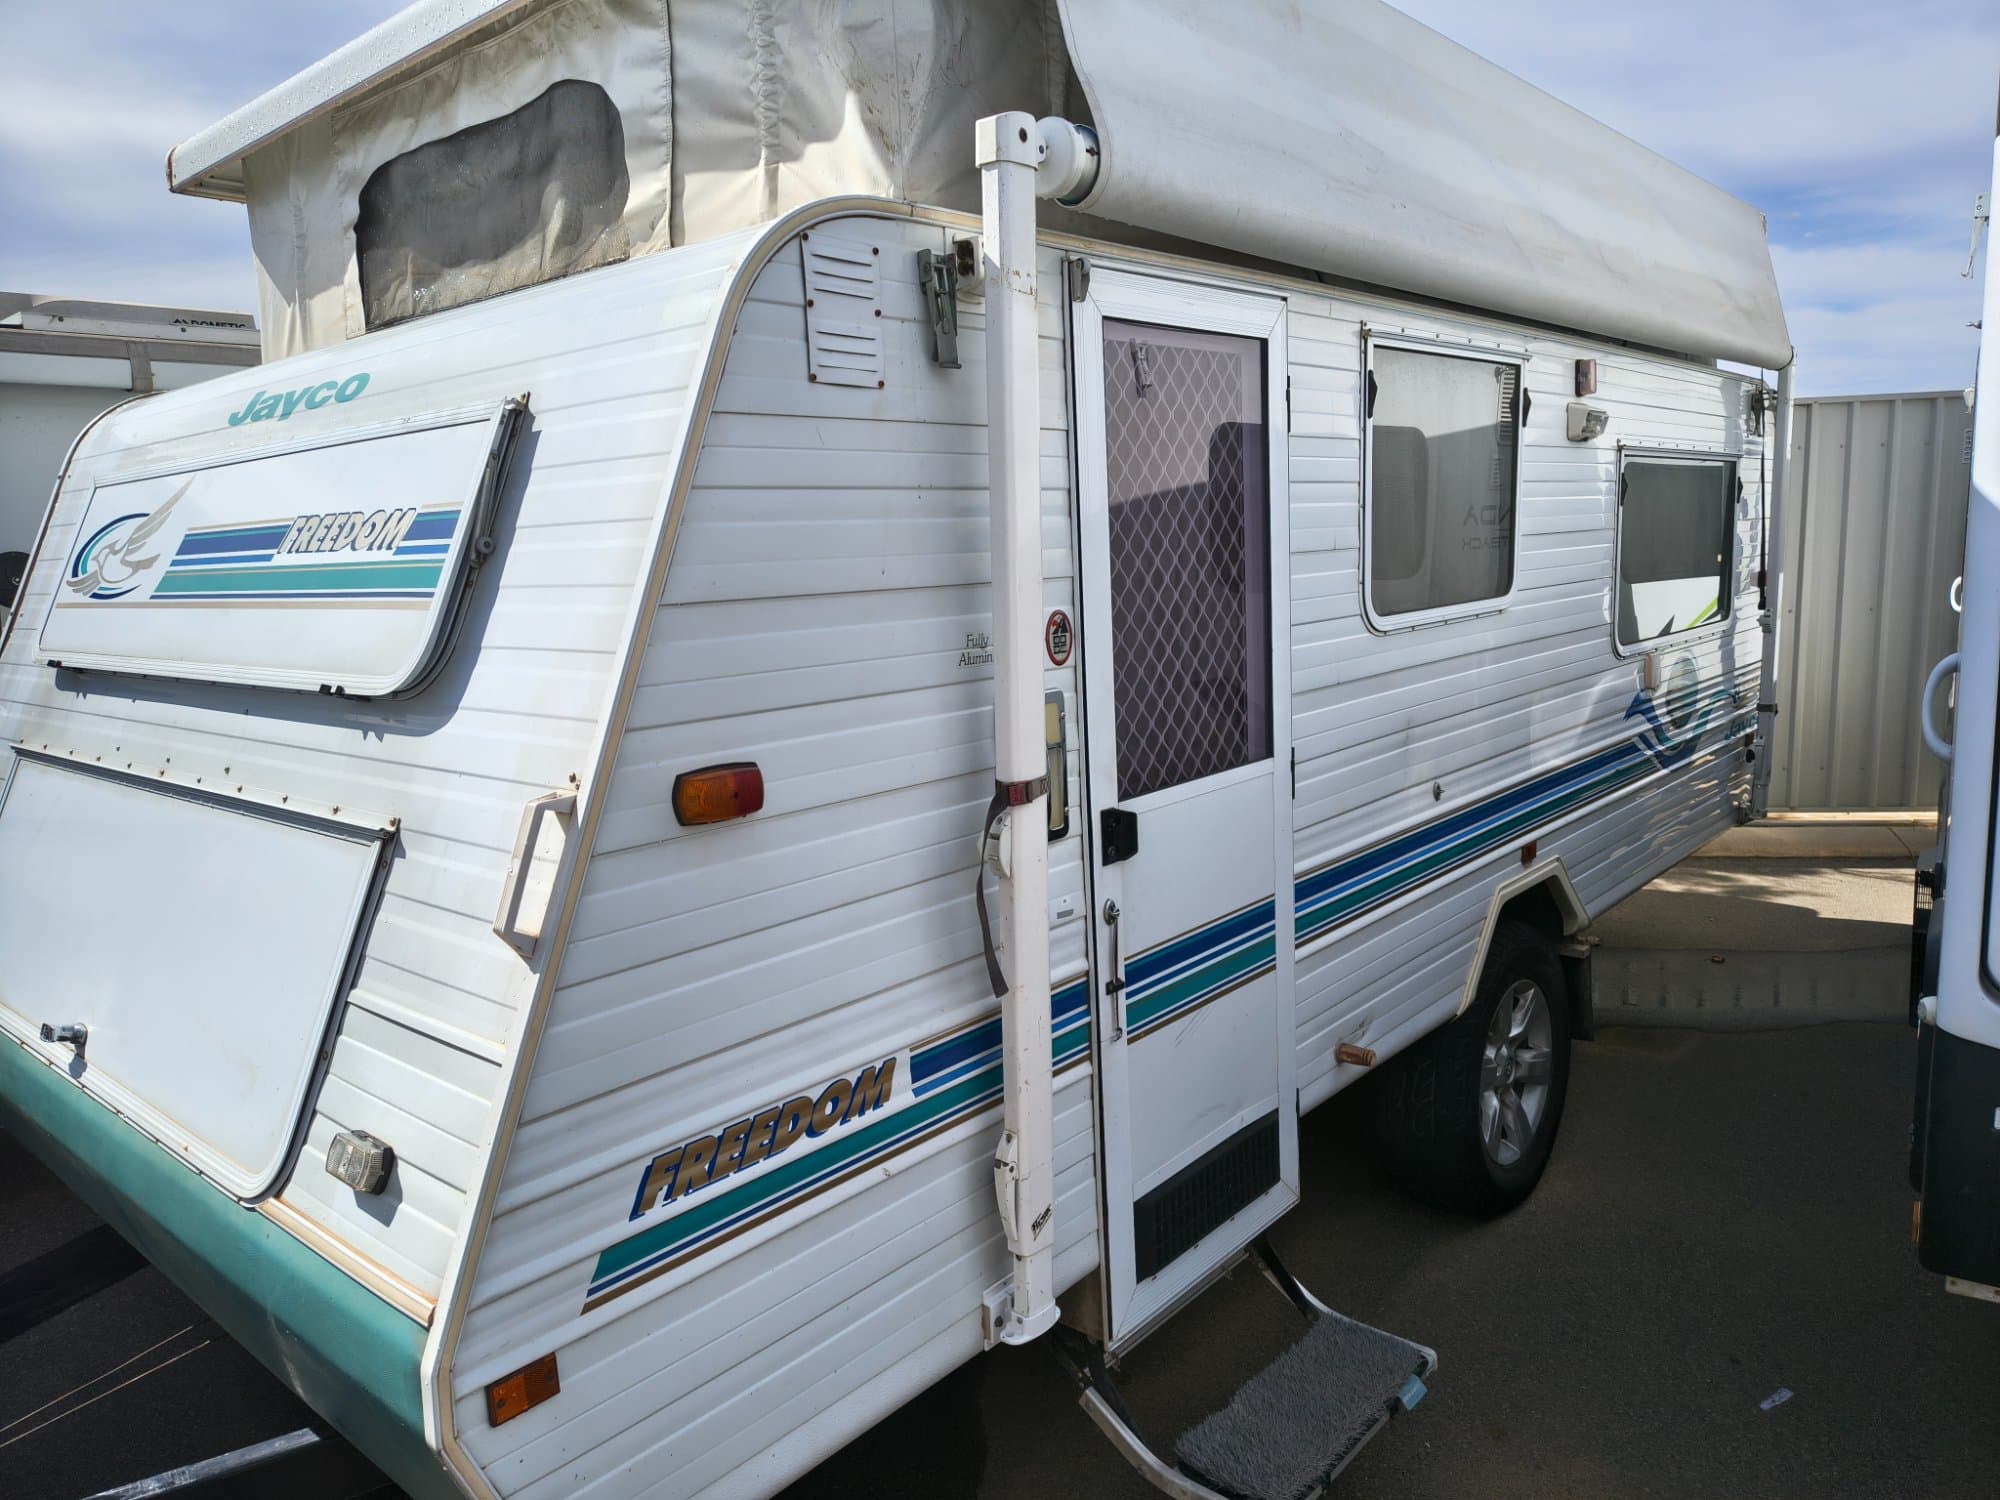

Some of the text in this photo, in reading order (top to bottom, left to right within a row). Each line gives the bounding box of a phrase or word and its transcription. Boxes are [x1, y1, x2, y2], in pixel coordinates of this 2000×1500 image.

[228, 373, 371, 427] Jayco
[276, 508, 416, 555] FREEDOM
[958, 651, 993, 666] Alumin
[966, 632, 989, 649] Fully
[629, 1057, 897, 1222] FREEDOM
